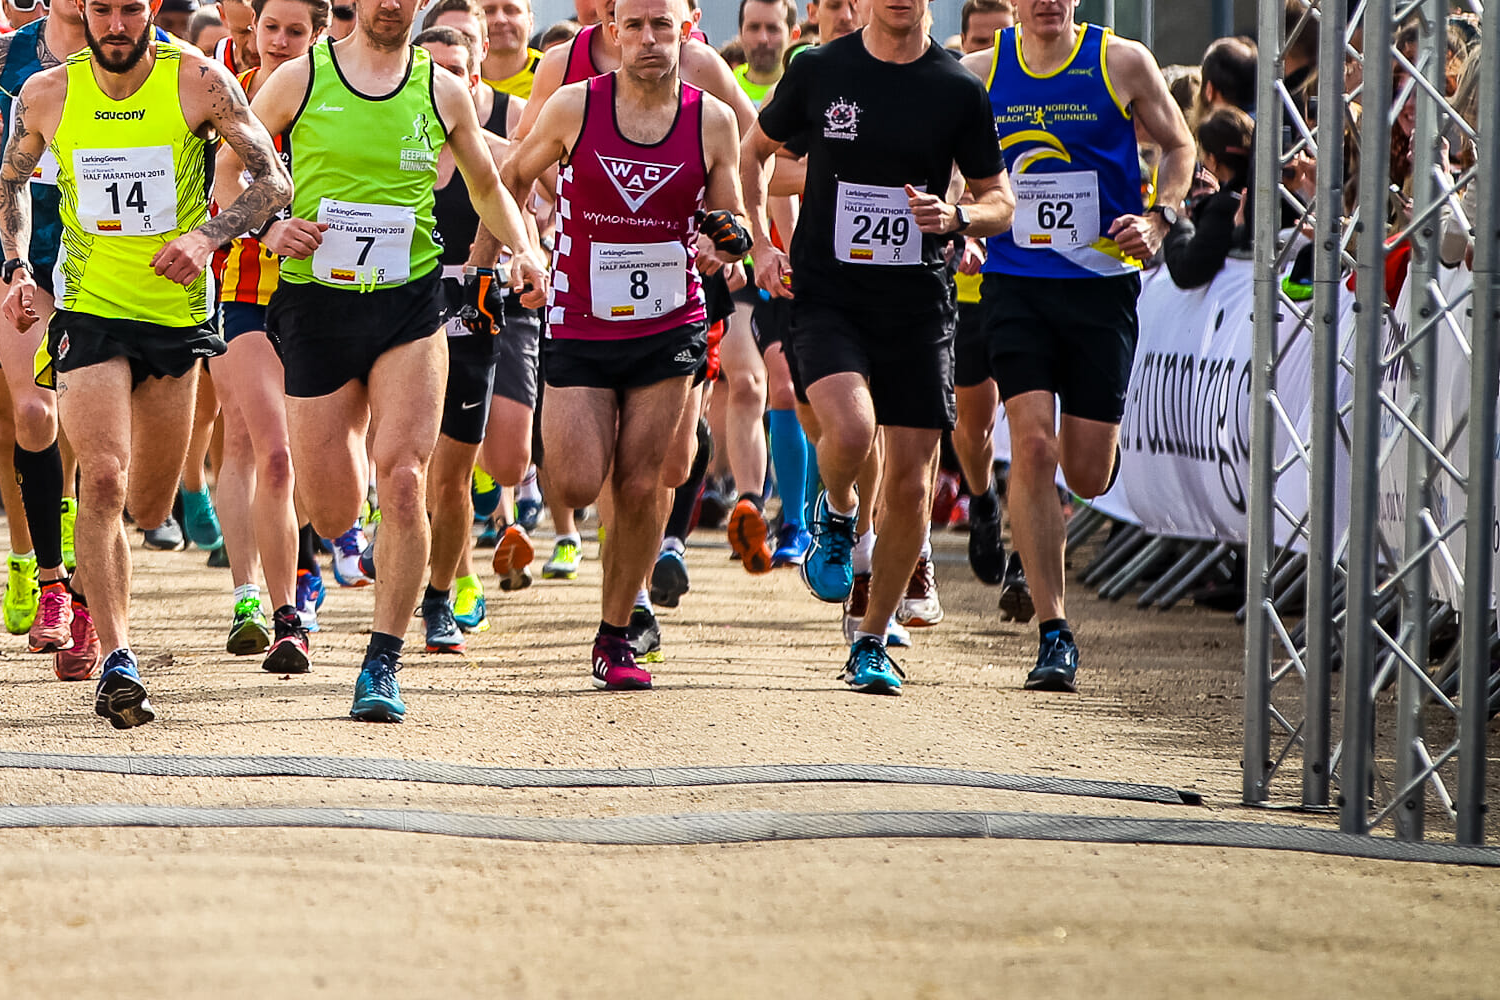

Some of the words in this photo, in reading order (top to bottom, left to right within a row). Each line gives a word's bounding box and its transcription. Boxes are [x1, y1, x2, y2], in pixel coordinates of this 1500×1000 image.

[94, 108, 146, 120] saucony
[1006, 104, 1037, 113] NORTH
[1045, 103, 1088, 112] NORFOLK
[996, 114, 1024, 124] BEACH
[1054, 112, 1098, 121] RUNNERS
[102, 171, 146, 180] MARATHON
[147, 169, 165, 178] 2018
[105, 181, 147, 215] 14
[1036, 192, 1074, 200] MARATHON
[1075, 191, 1091, 199] 2018
[844, 205, 862, 213] HALF
[863, 206, 904, 215] MARATHON
[1037, 201, 1075, 230] 62
[345, 225, 388, 234] MARATHON
[851, 215, 910, 246] 249
[355, 236, 375, 266] 7
[619, 262, 660, 270] MARATHON
[630, 270, 650, 300] 8
